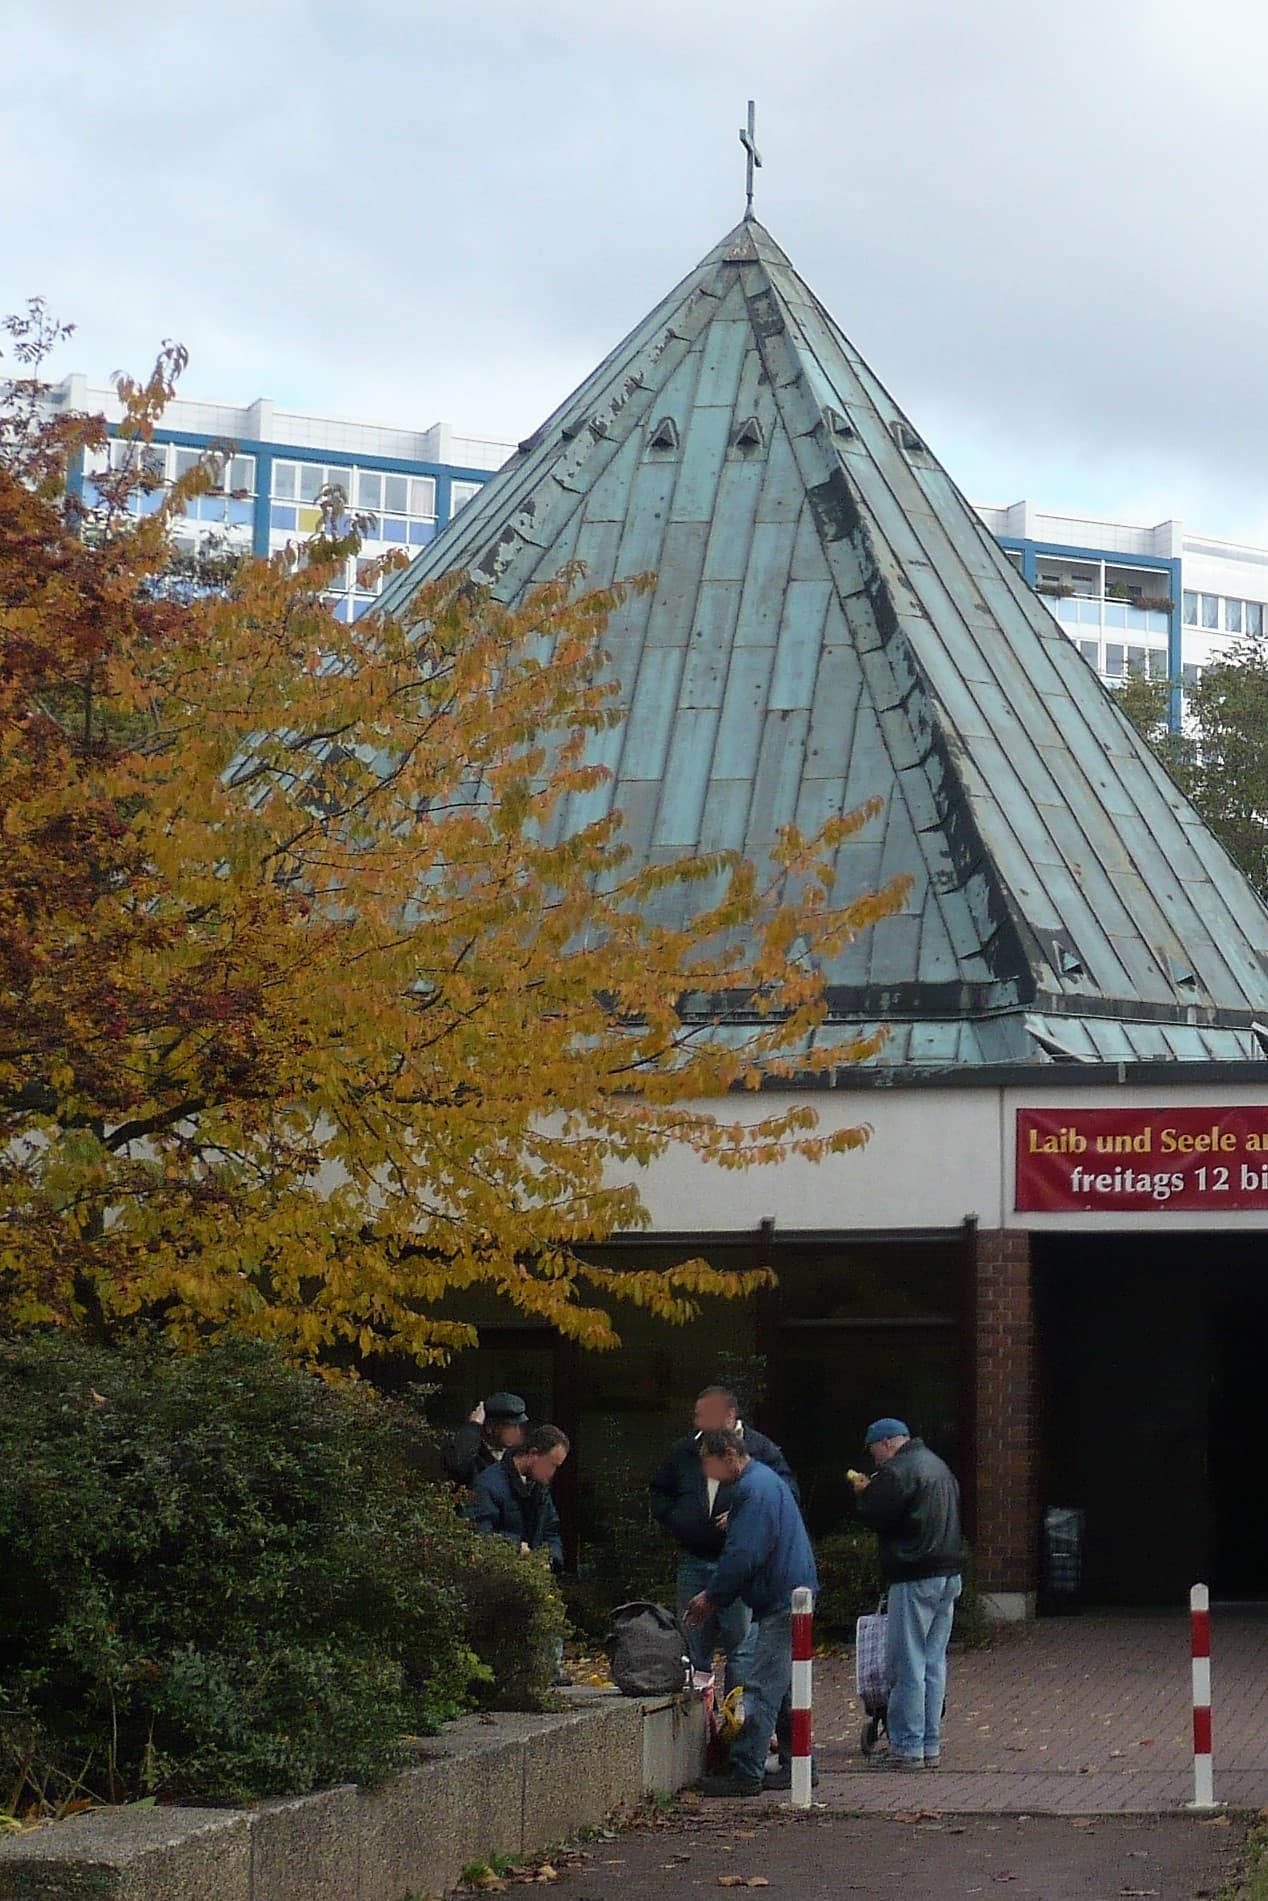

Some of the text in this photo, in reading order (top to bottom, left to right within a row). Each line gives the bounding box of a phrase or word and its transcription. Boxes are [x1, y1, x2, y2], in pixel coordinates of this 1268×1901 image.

[1028, 1127, 1088, 1154] Laib
[1096, 1126, 1152, 1153] und
[1160, 1125, 1236, 1153] Seele
[1070, 1165, 1185, 1199] freitags
[1195, 1166, 1230, 1191] 12
